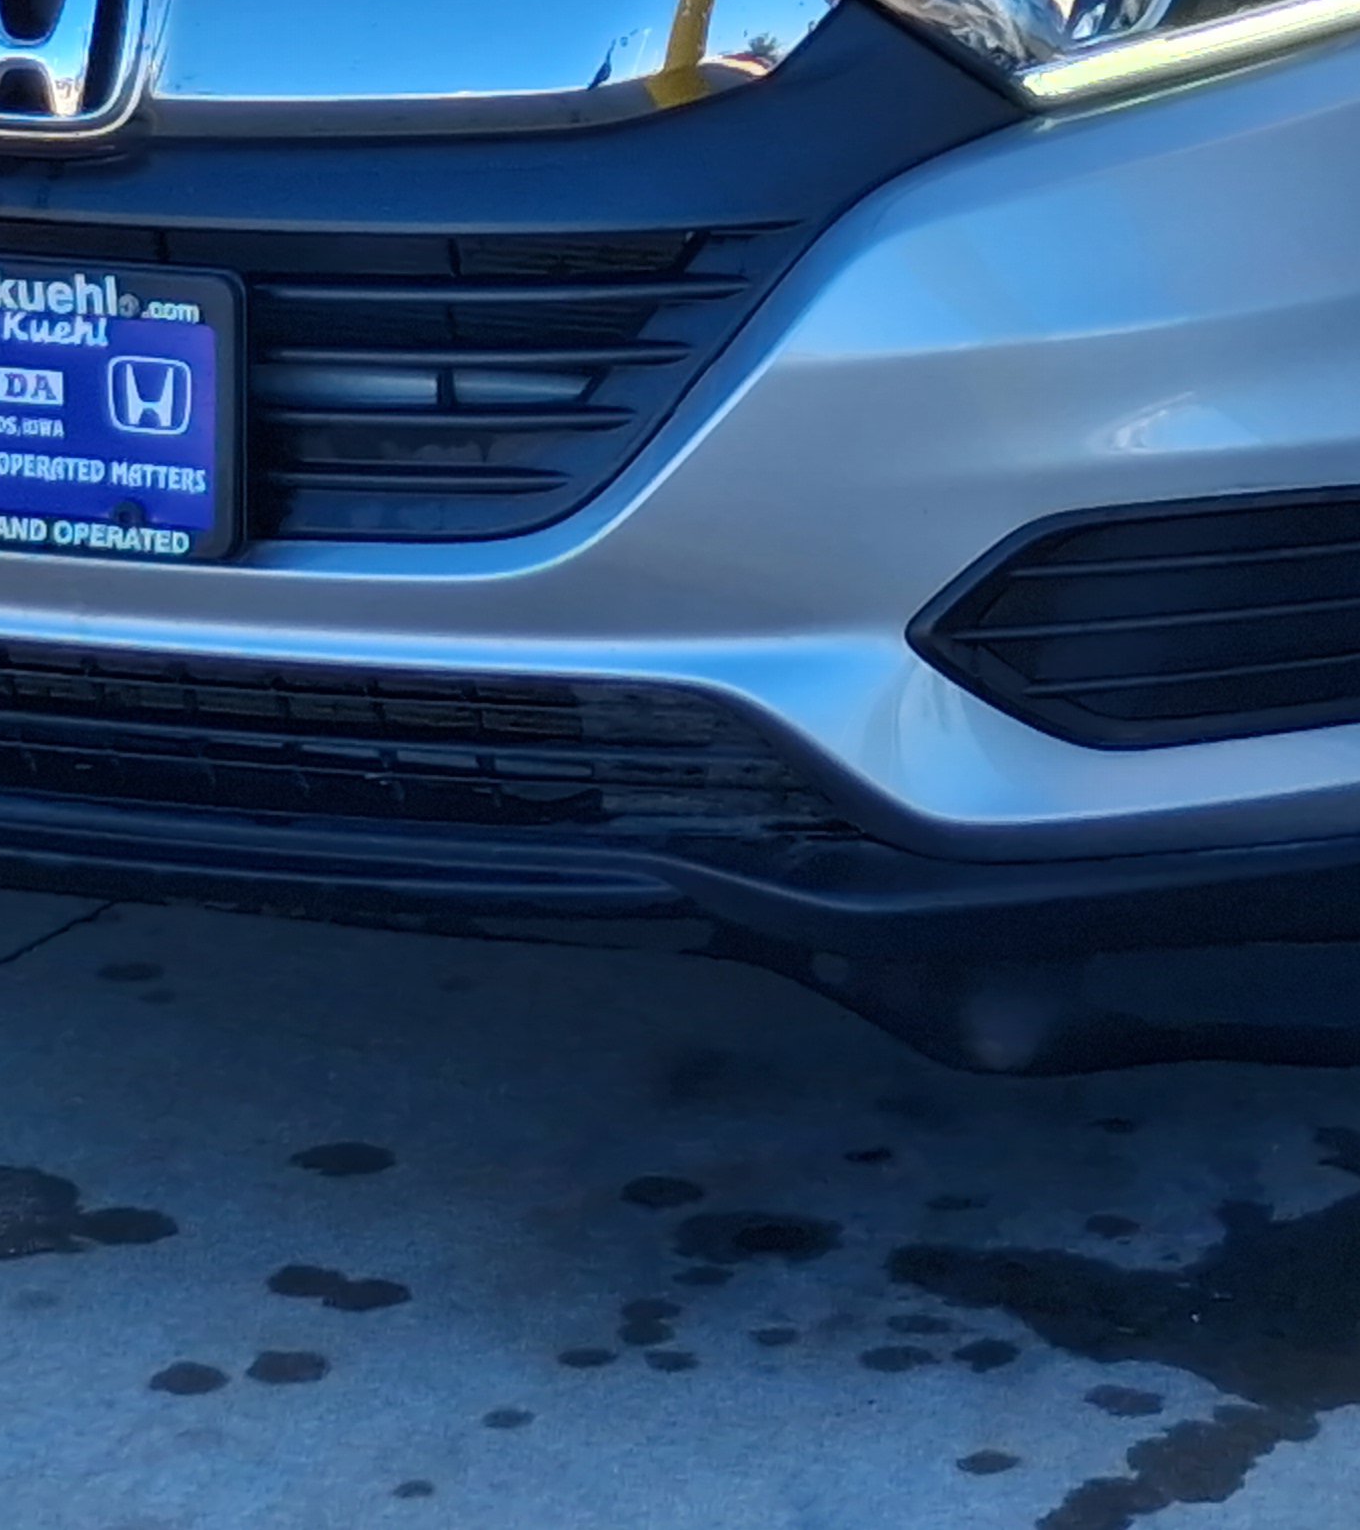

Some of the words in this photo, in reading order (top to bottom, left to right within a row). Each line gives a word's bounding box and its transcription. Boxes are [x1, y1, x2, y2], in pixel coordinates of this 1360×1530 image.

[2, 311, 109, 347] Kuehl
[111, 460, 207, 494] MATTERS
[53, 520, 190, 555] OPERATED
